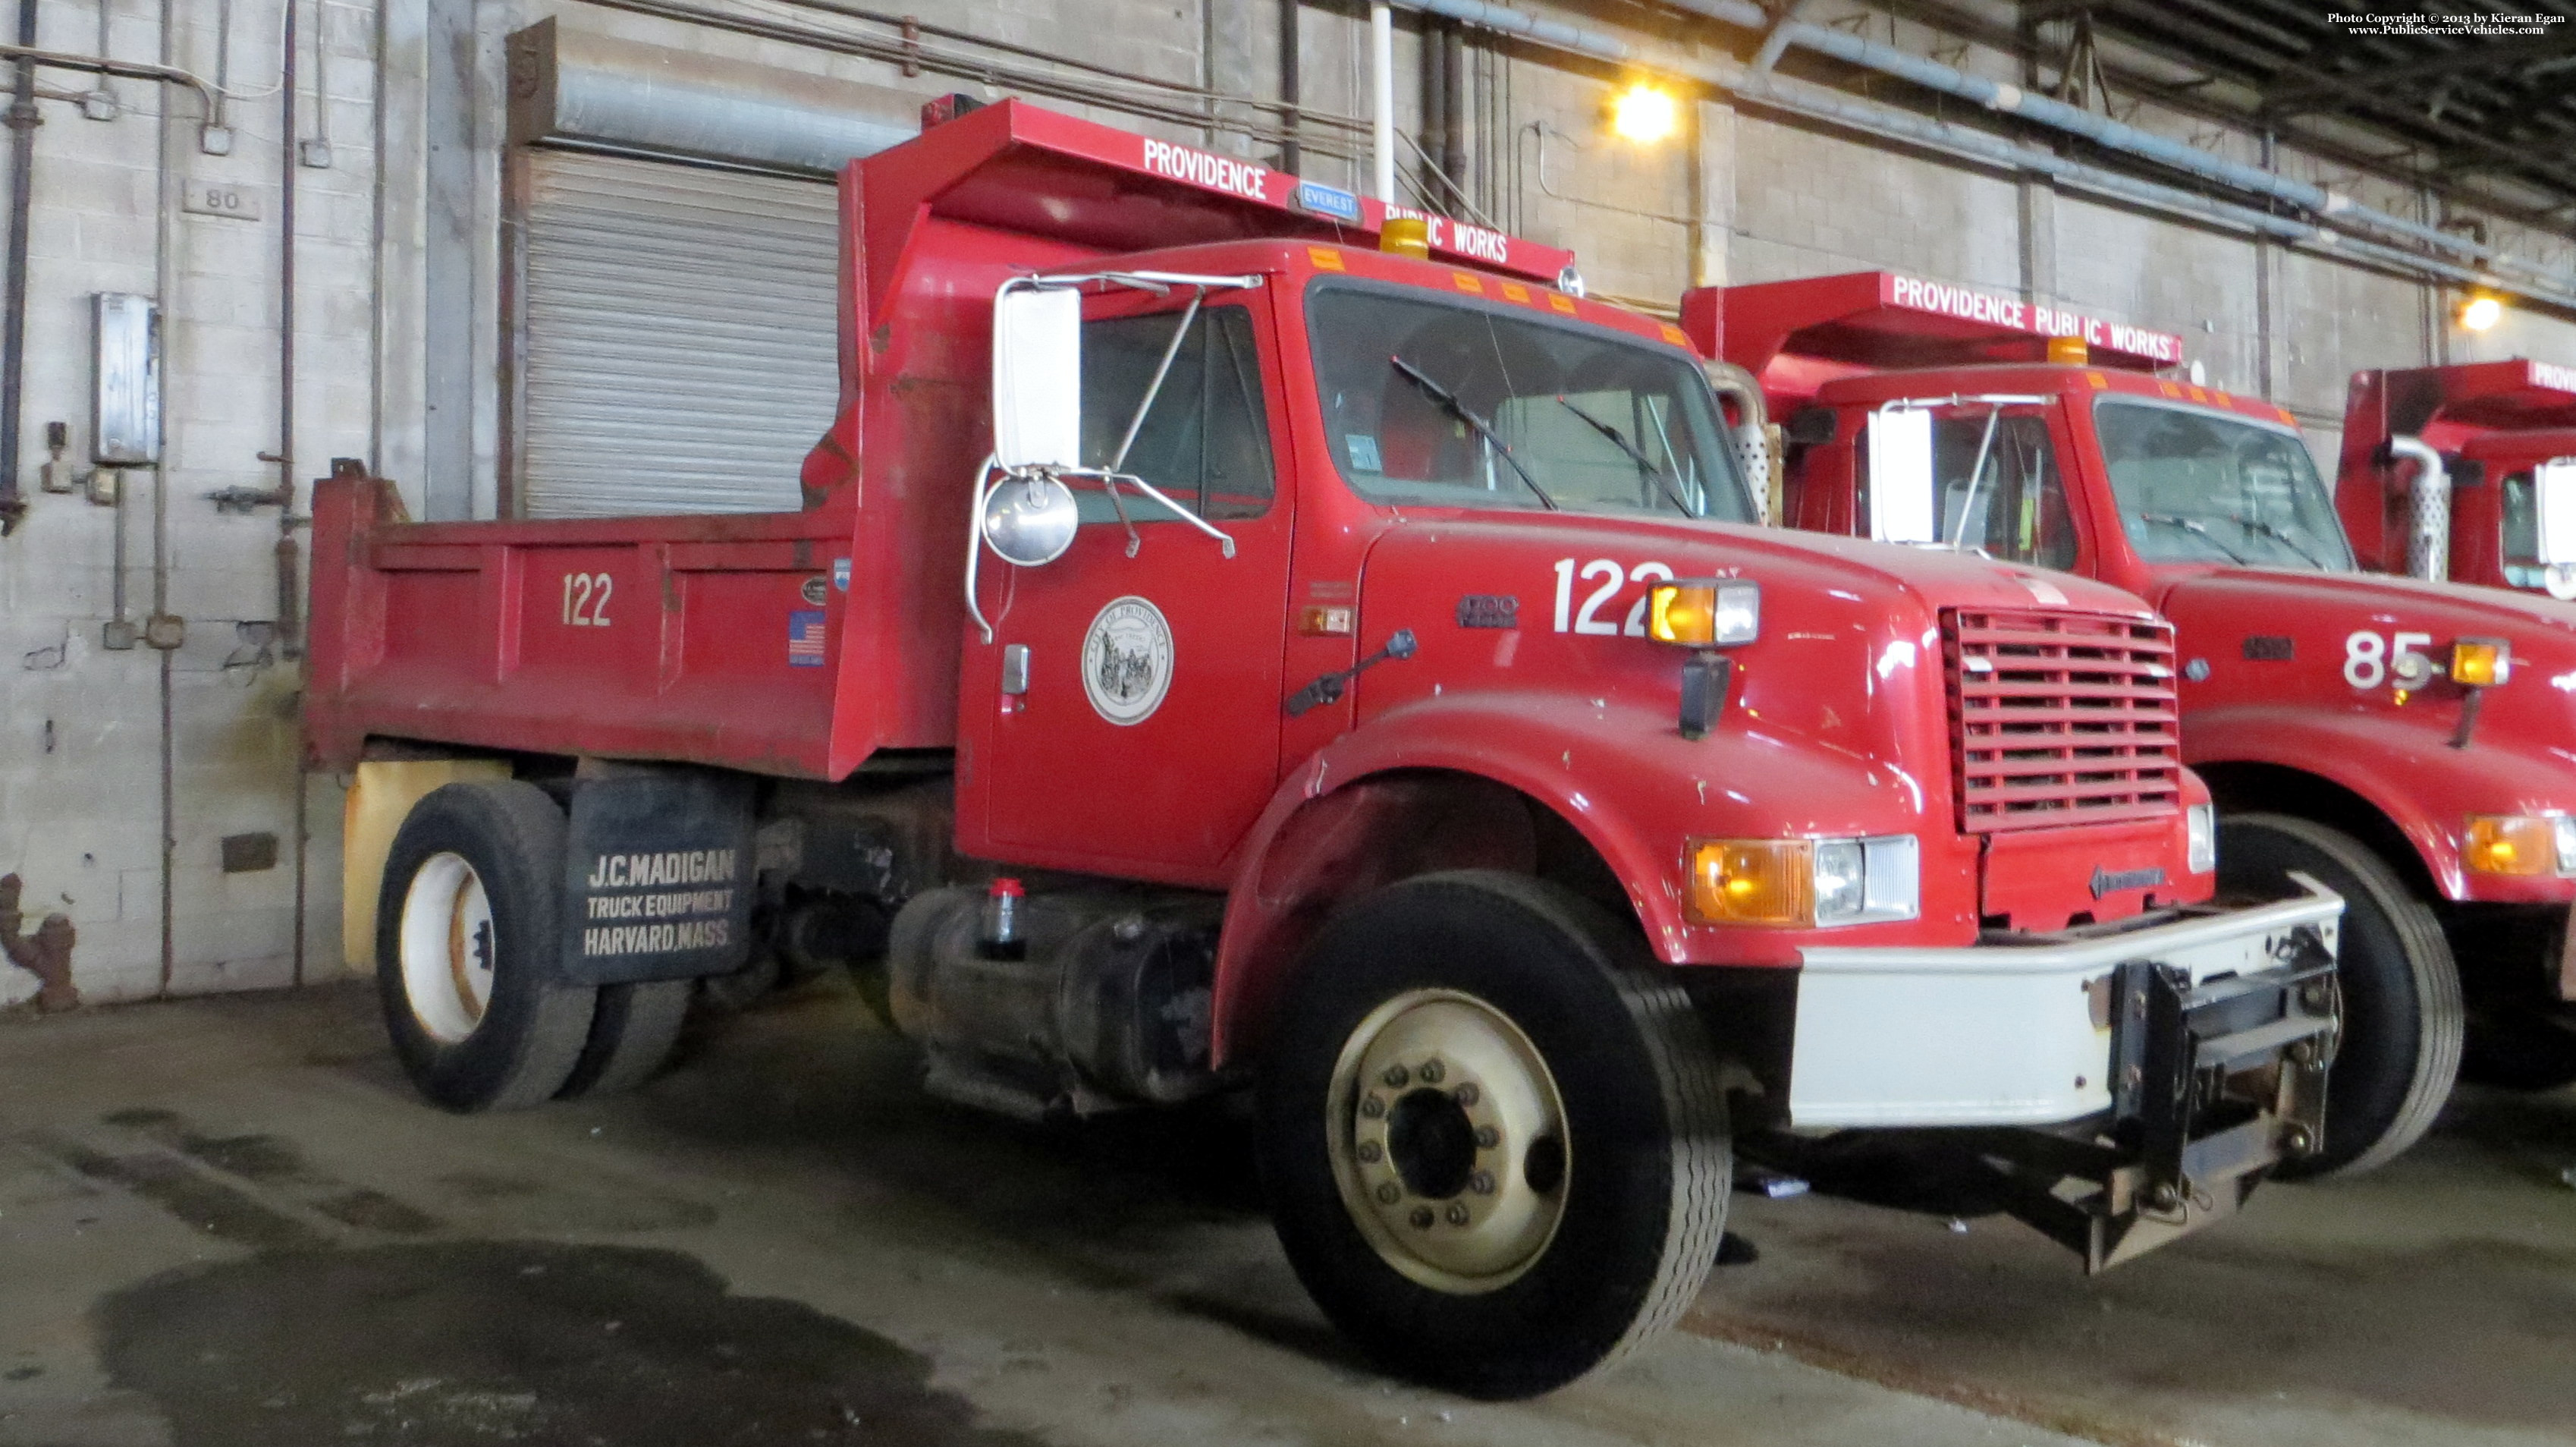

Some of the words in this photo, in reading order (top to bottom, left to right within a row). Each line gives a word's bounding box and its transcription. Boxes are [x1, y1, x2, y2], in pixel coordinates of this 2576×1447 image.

[206, 189, 238, 209] 80
[1144, 138, 1266, 199] PROVIDENCE
[1385, 204, 1443, 246] PIC
[1454, 222, 1506, 263] WORKS
[1305, 187, 1353, 212] EVEREST
[1893, 275, 2025, 329] PROVIDENCE
[2110, 322, 2171, 360] WORKS
[563, 572, 612, 626] 122
[1554, 558, 1673, 637] 122
[2344, 631, 2431, 690] 85
[588, 895, 643, 919] TRUCK
[646, 889, 734, 917] EQUIPMENT
